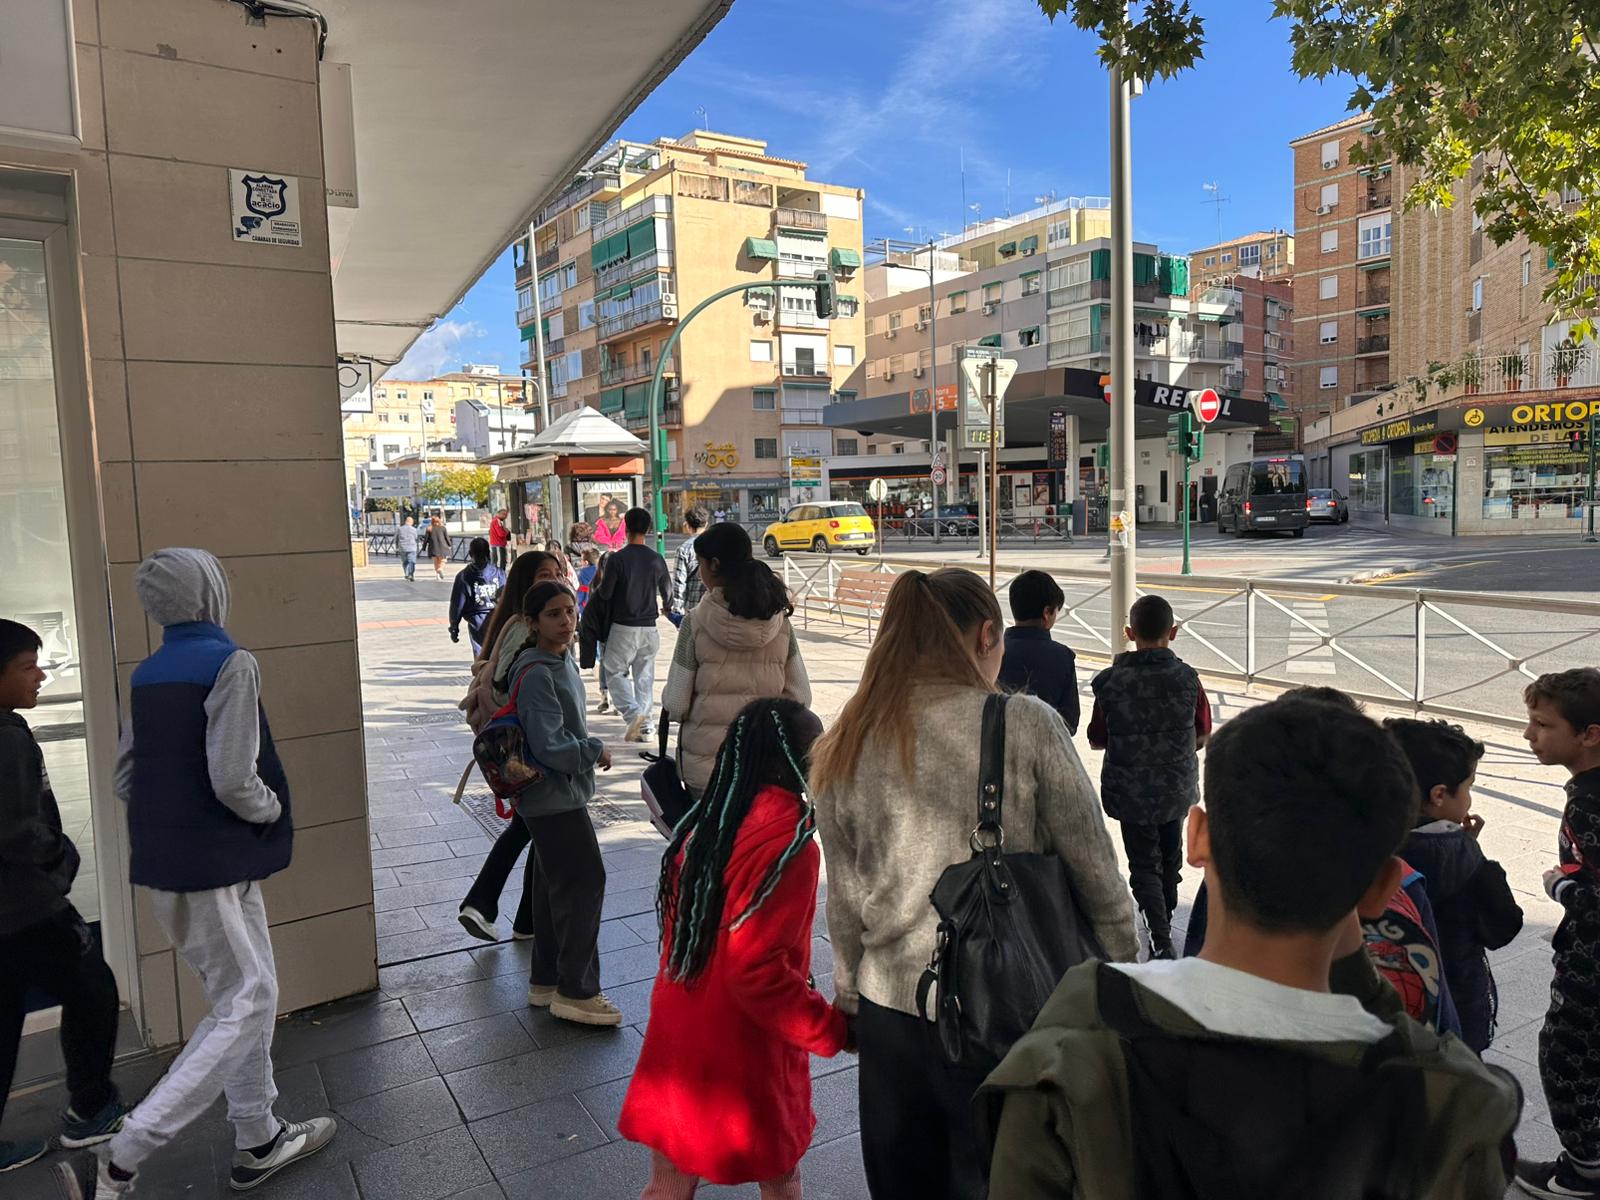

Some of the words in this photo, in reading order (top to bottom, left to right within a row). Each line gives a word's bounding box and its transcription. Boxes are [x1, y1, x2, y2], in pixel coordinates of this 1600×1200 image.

[252, 200, 280, 209] acacio
[1489, 421, 1585, 434] ATENDEMOS
[1530, 433, 1549, 443] DE
